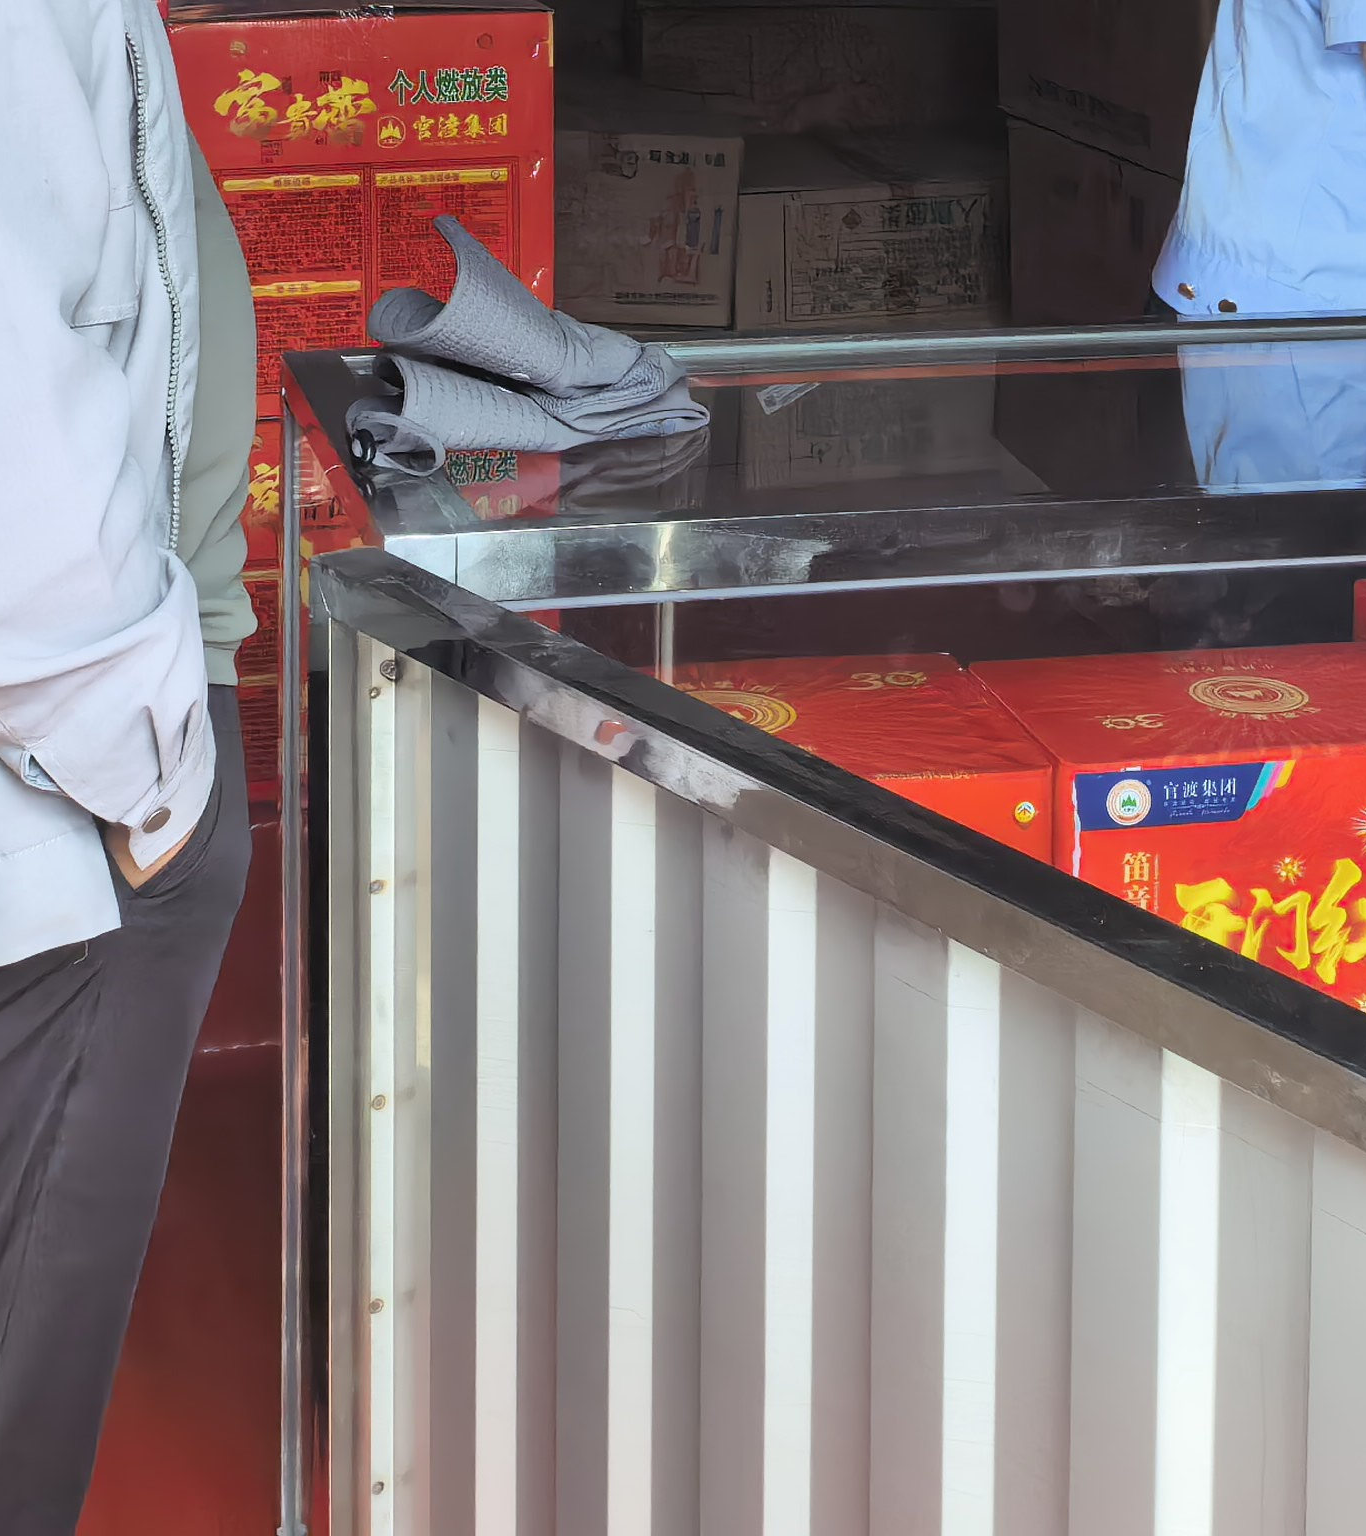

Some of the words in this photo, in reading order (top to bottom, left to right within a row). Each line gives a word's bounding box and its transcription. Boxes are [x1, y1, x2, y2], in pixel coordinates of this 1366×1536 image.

[389, 66, 508, 107] 个人燃放类
[1163, 778, 1236, 800] 官渡集团
